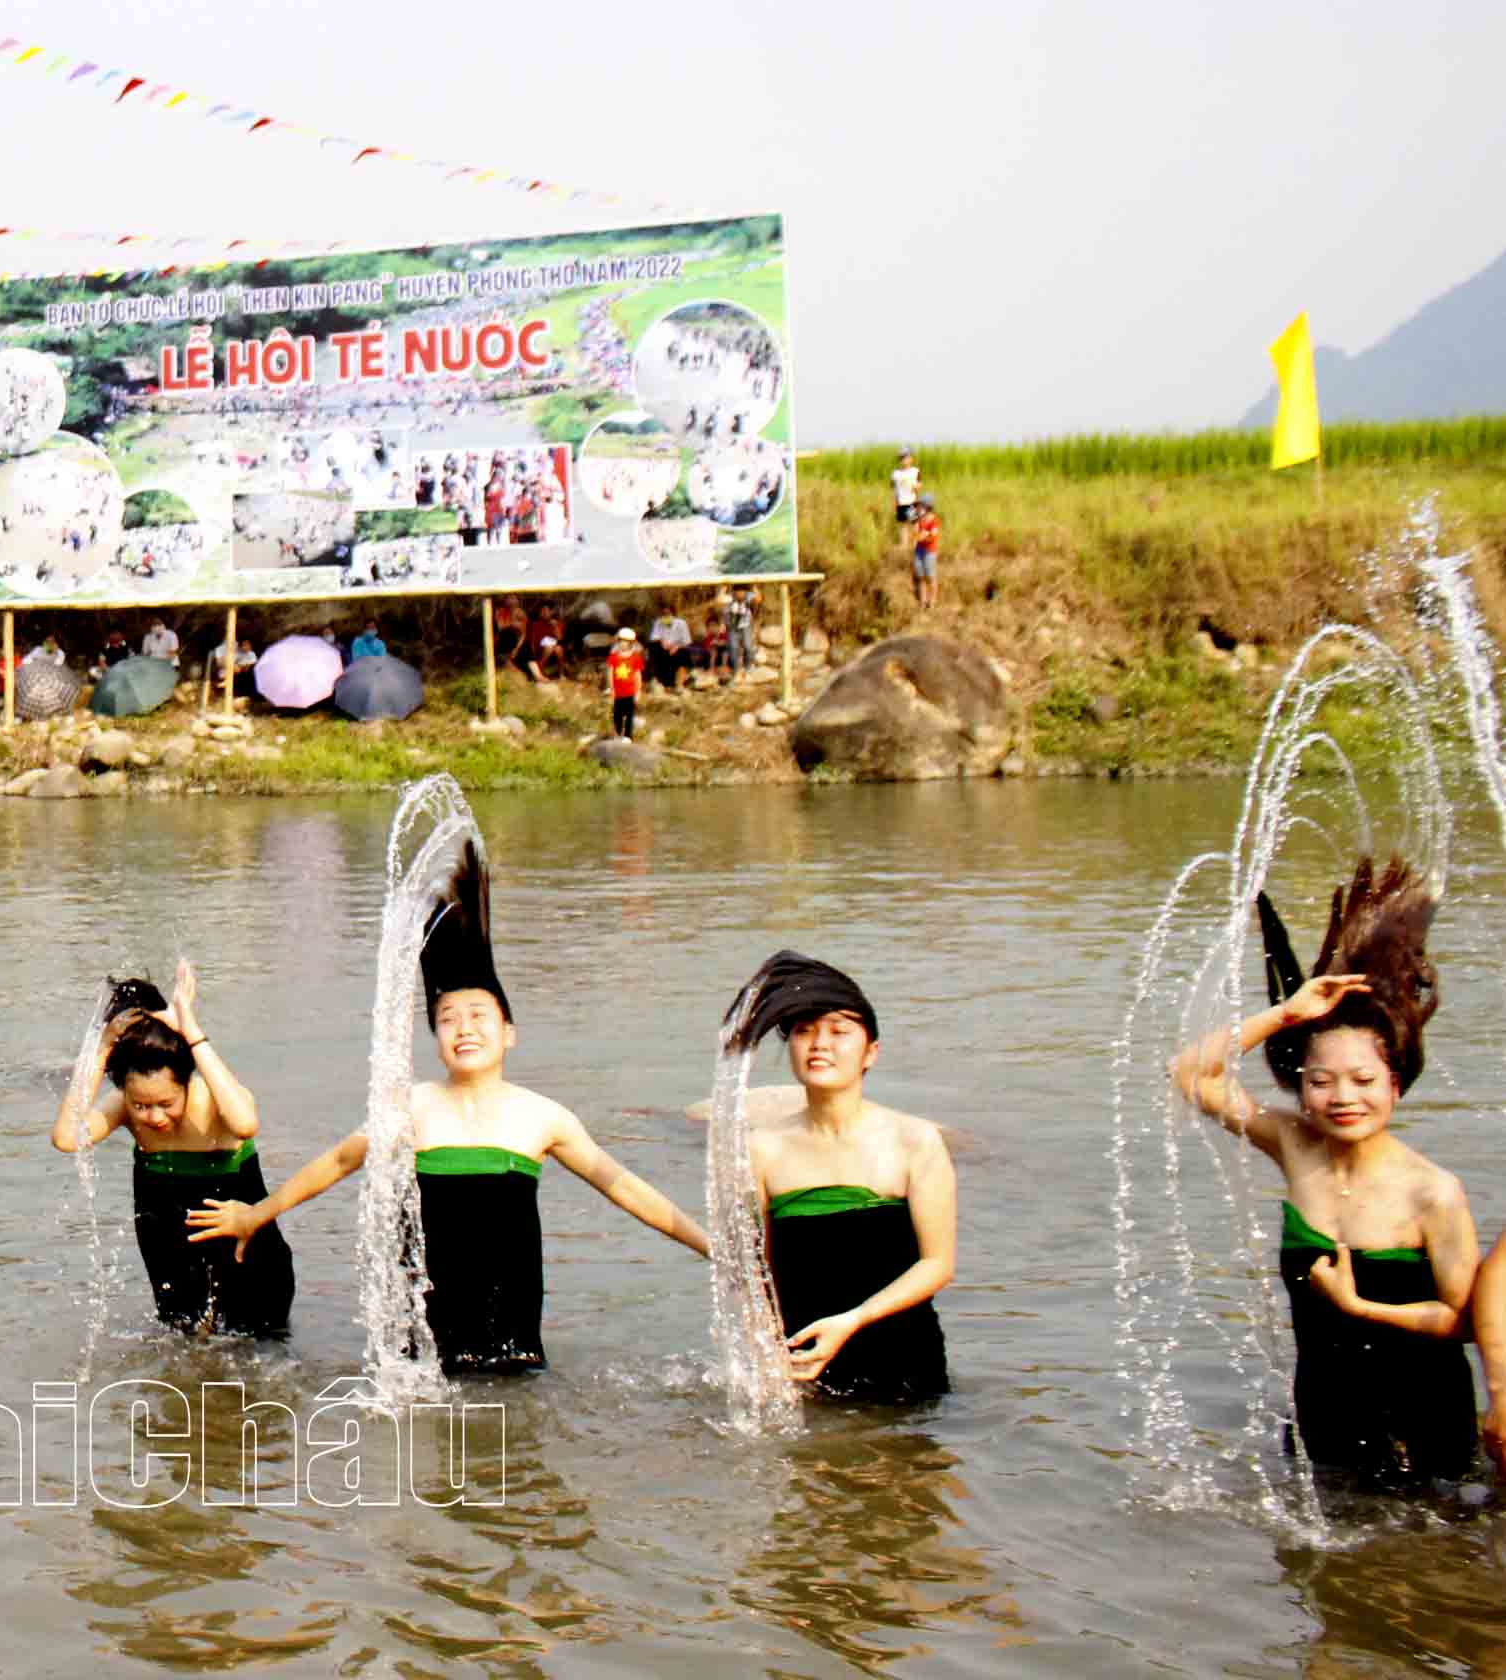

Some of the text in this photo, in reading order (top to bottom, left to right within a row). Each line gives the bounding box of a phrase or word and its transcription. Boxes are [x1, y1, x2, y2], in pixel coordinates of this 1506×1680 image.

[47, 303, 84, 326] BAN
[293, 285, 327, 309] KIN
[635, 255, 681, 279] 2022
[162, 310, 549, 397] LỄ HỘI TÉ NƯỚC
